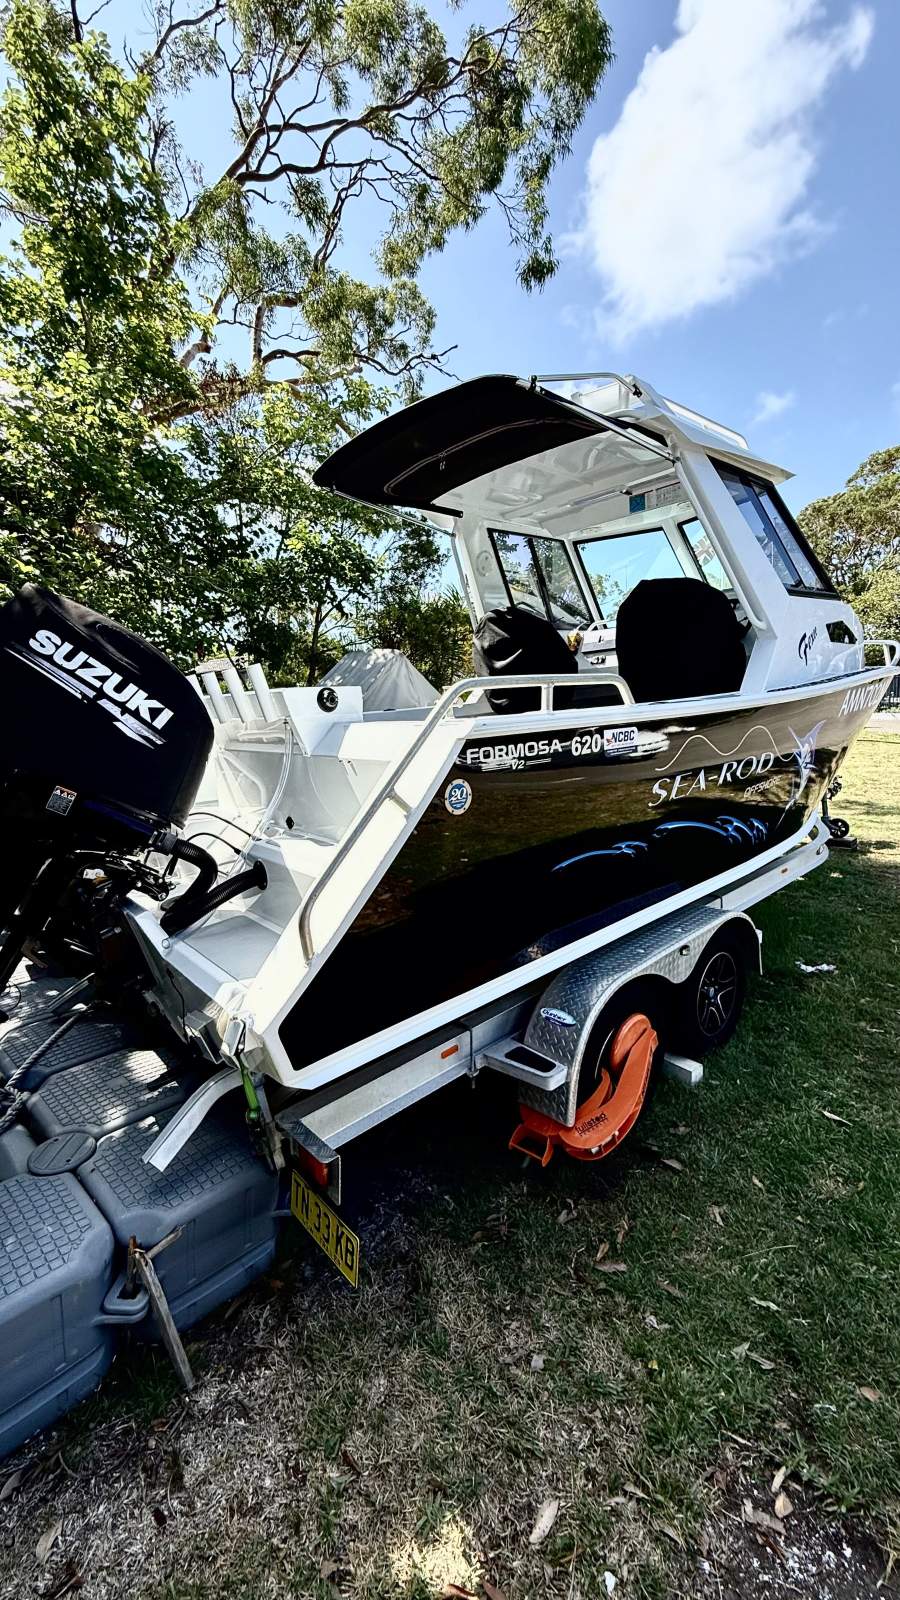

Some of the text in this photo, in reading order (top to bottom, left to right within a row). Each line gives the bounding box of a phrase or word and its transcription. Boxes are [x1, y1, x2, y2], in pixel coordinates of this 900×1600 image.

[28, 629, 174, 730] SUZUKI
[612, 730, 635, 743] NCBC
[466, 738, 562, 764] FORMOSA
[571, 734, 601, 757] 620
[511, 759, 525, 770] V2
[647, 752, 775, 807] SEA-ROD
[448, 787, 467, 802] 20
